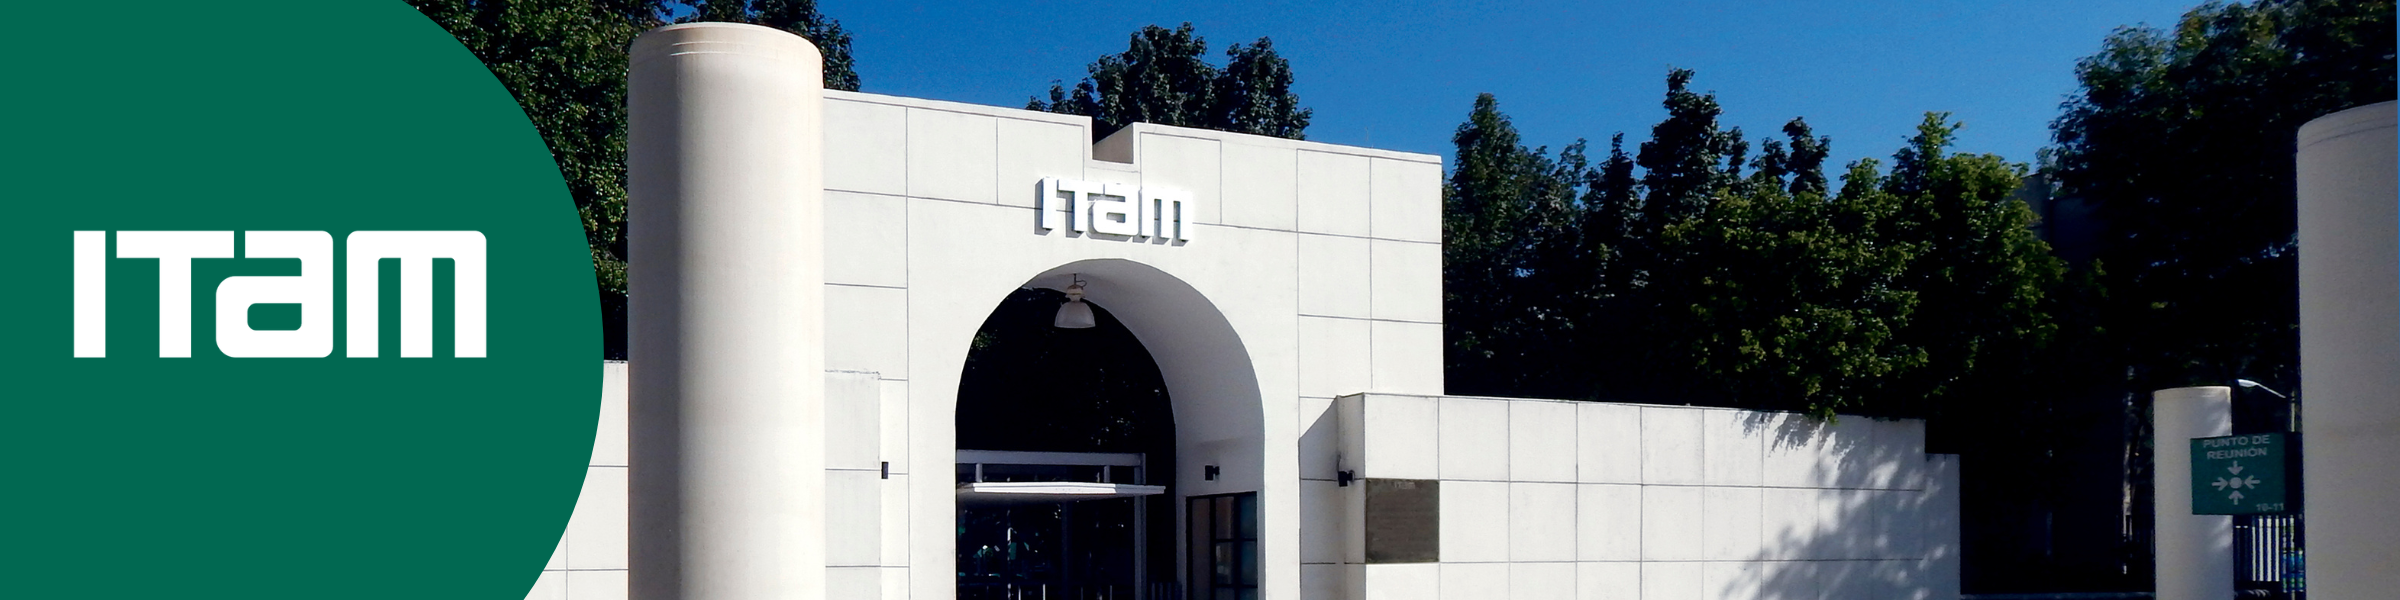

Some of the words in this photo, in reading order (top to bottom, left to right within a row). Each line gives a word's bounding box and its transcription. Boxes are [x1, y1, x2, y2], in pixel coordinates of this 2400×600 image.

[2203, 437, 2249, 448] PUNTO
[2252, 435, 2270, 445] DE
[2207, 446, 2267, 459] REUNIÓN
